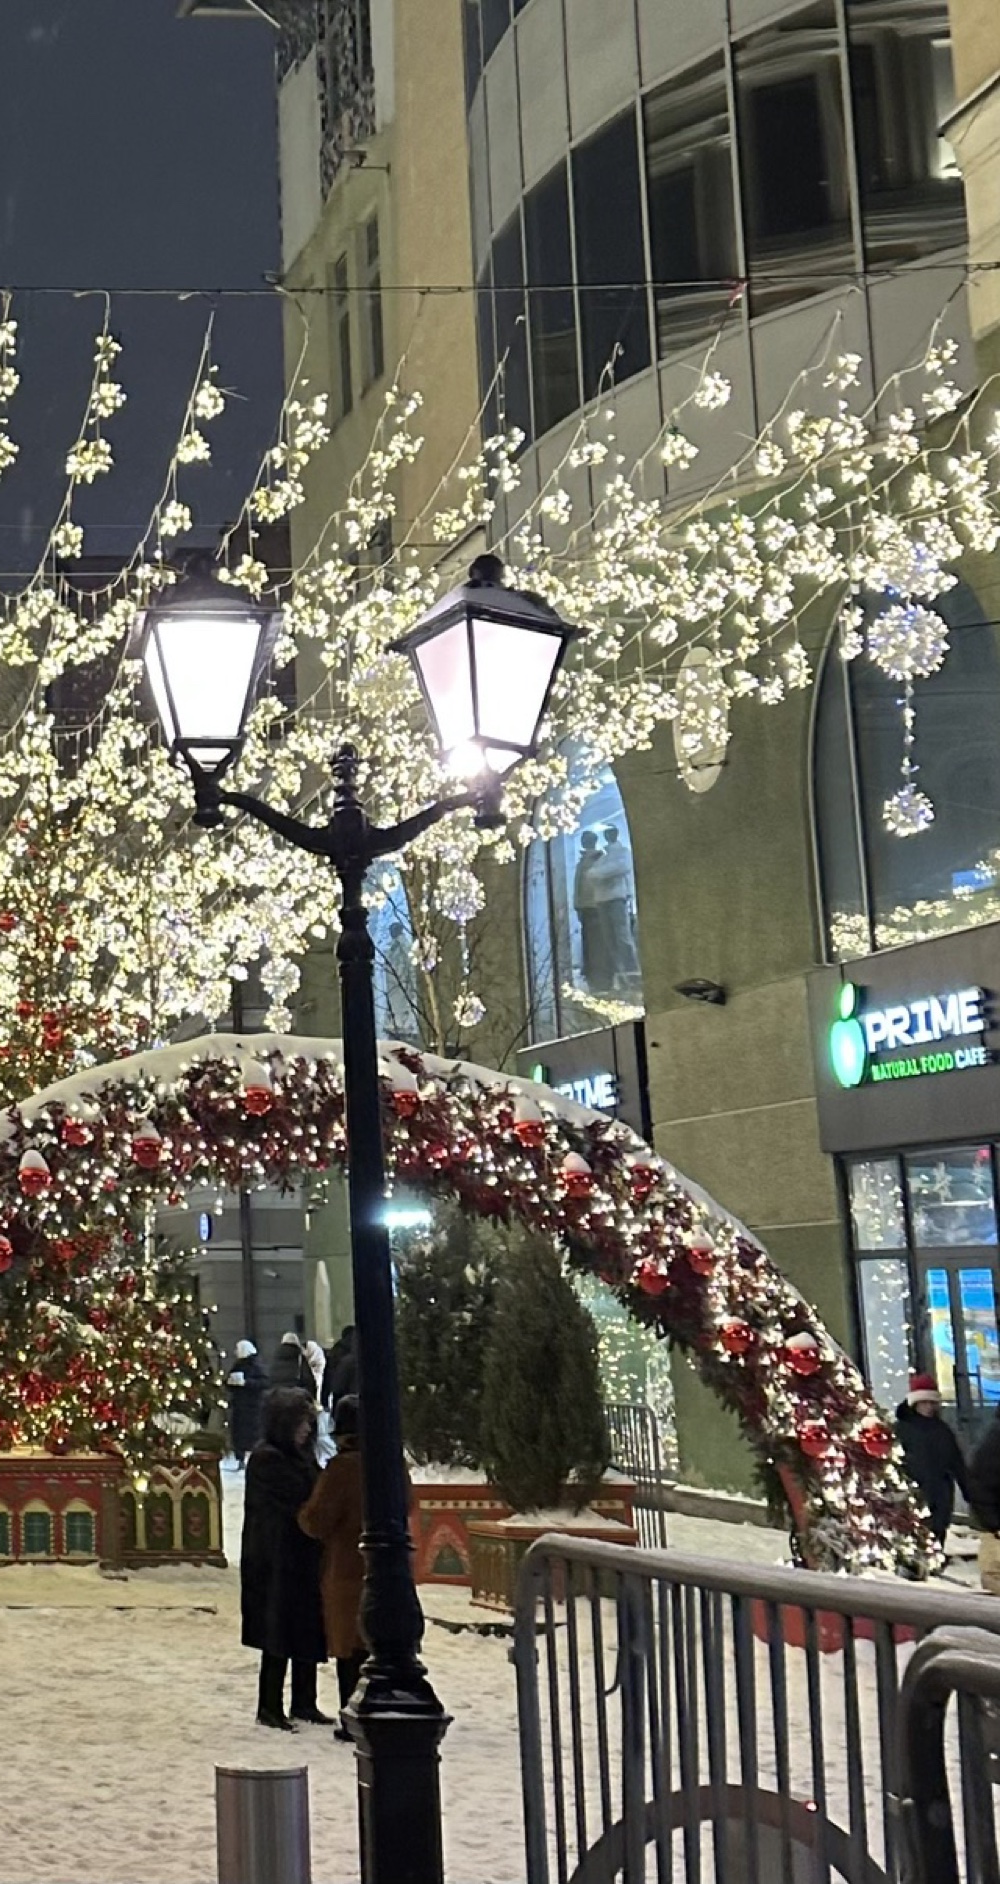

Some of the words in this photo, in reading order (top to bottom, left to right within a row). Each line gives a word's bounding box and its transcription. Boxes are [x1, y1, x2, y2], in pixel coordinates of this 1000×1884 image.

[863, 986, 985, 1053] PRIME
[871, 1059, 921, 1082] NATURAL
[921, 1052, 953, 1073] FOOD
[954, 1046, 986, 1069] CAFE
